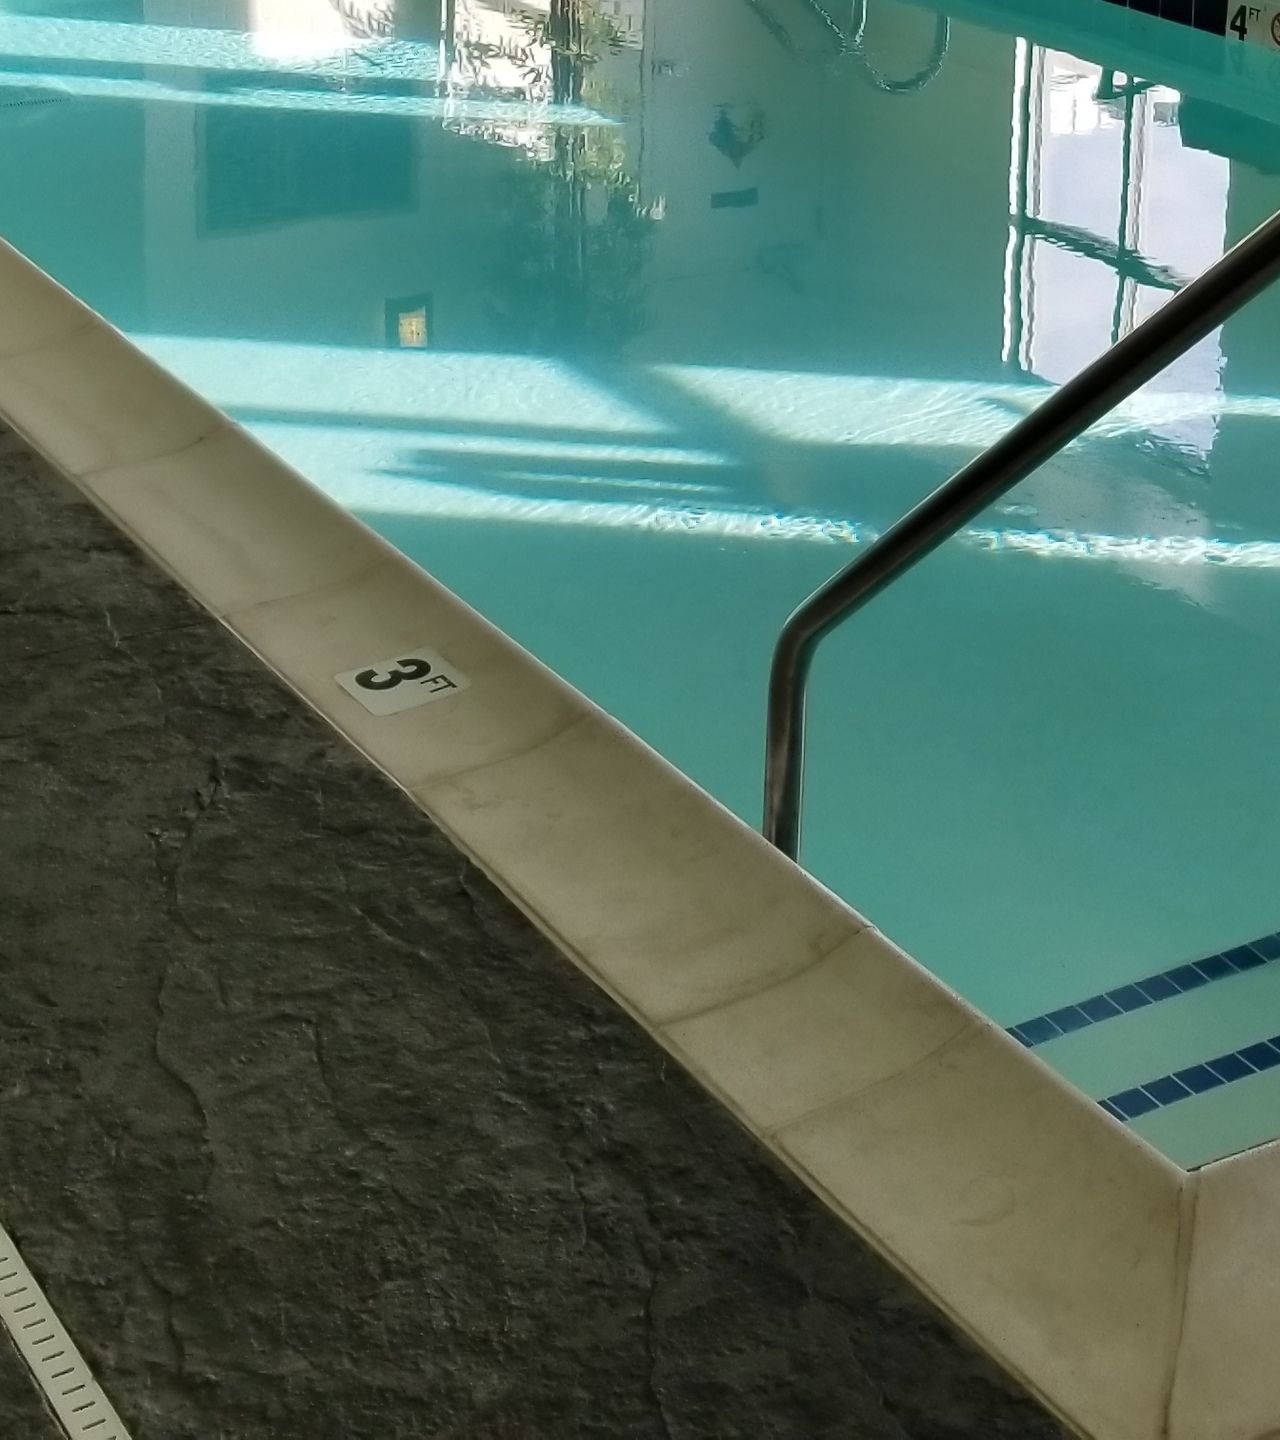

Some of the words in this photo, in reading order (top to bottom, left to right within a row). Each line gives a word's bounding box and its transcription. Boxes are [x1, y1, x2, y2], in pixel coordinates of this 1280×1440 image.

[1230, 4, 1248, 41] 4
[1249, 7, 1261, 22] FT
[355, 658, 432, 691] 3
[420, 674, 458, 693] FT
